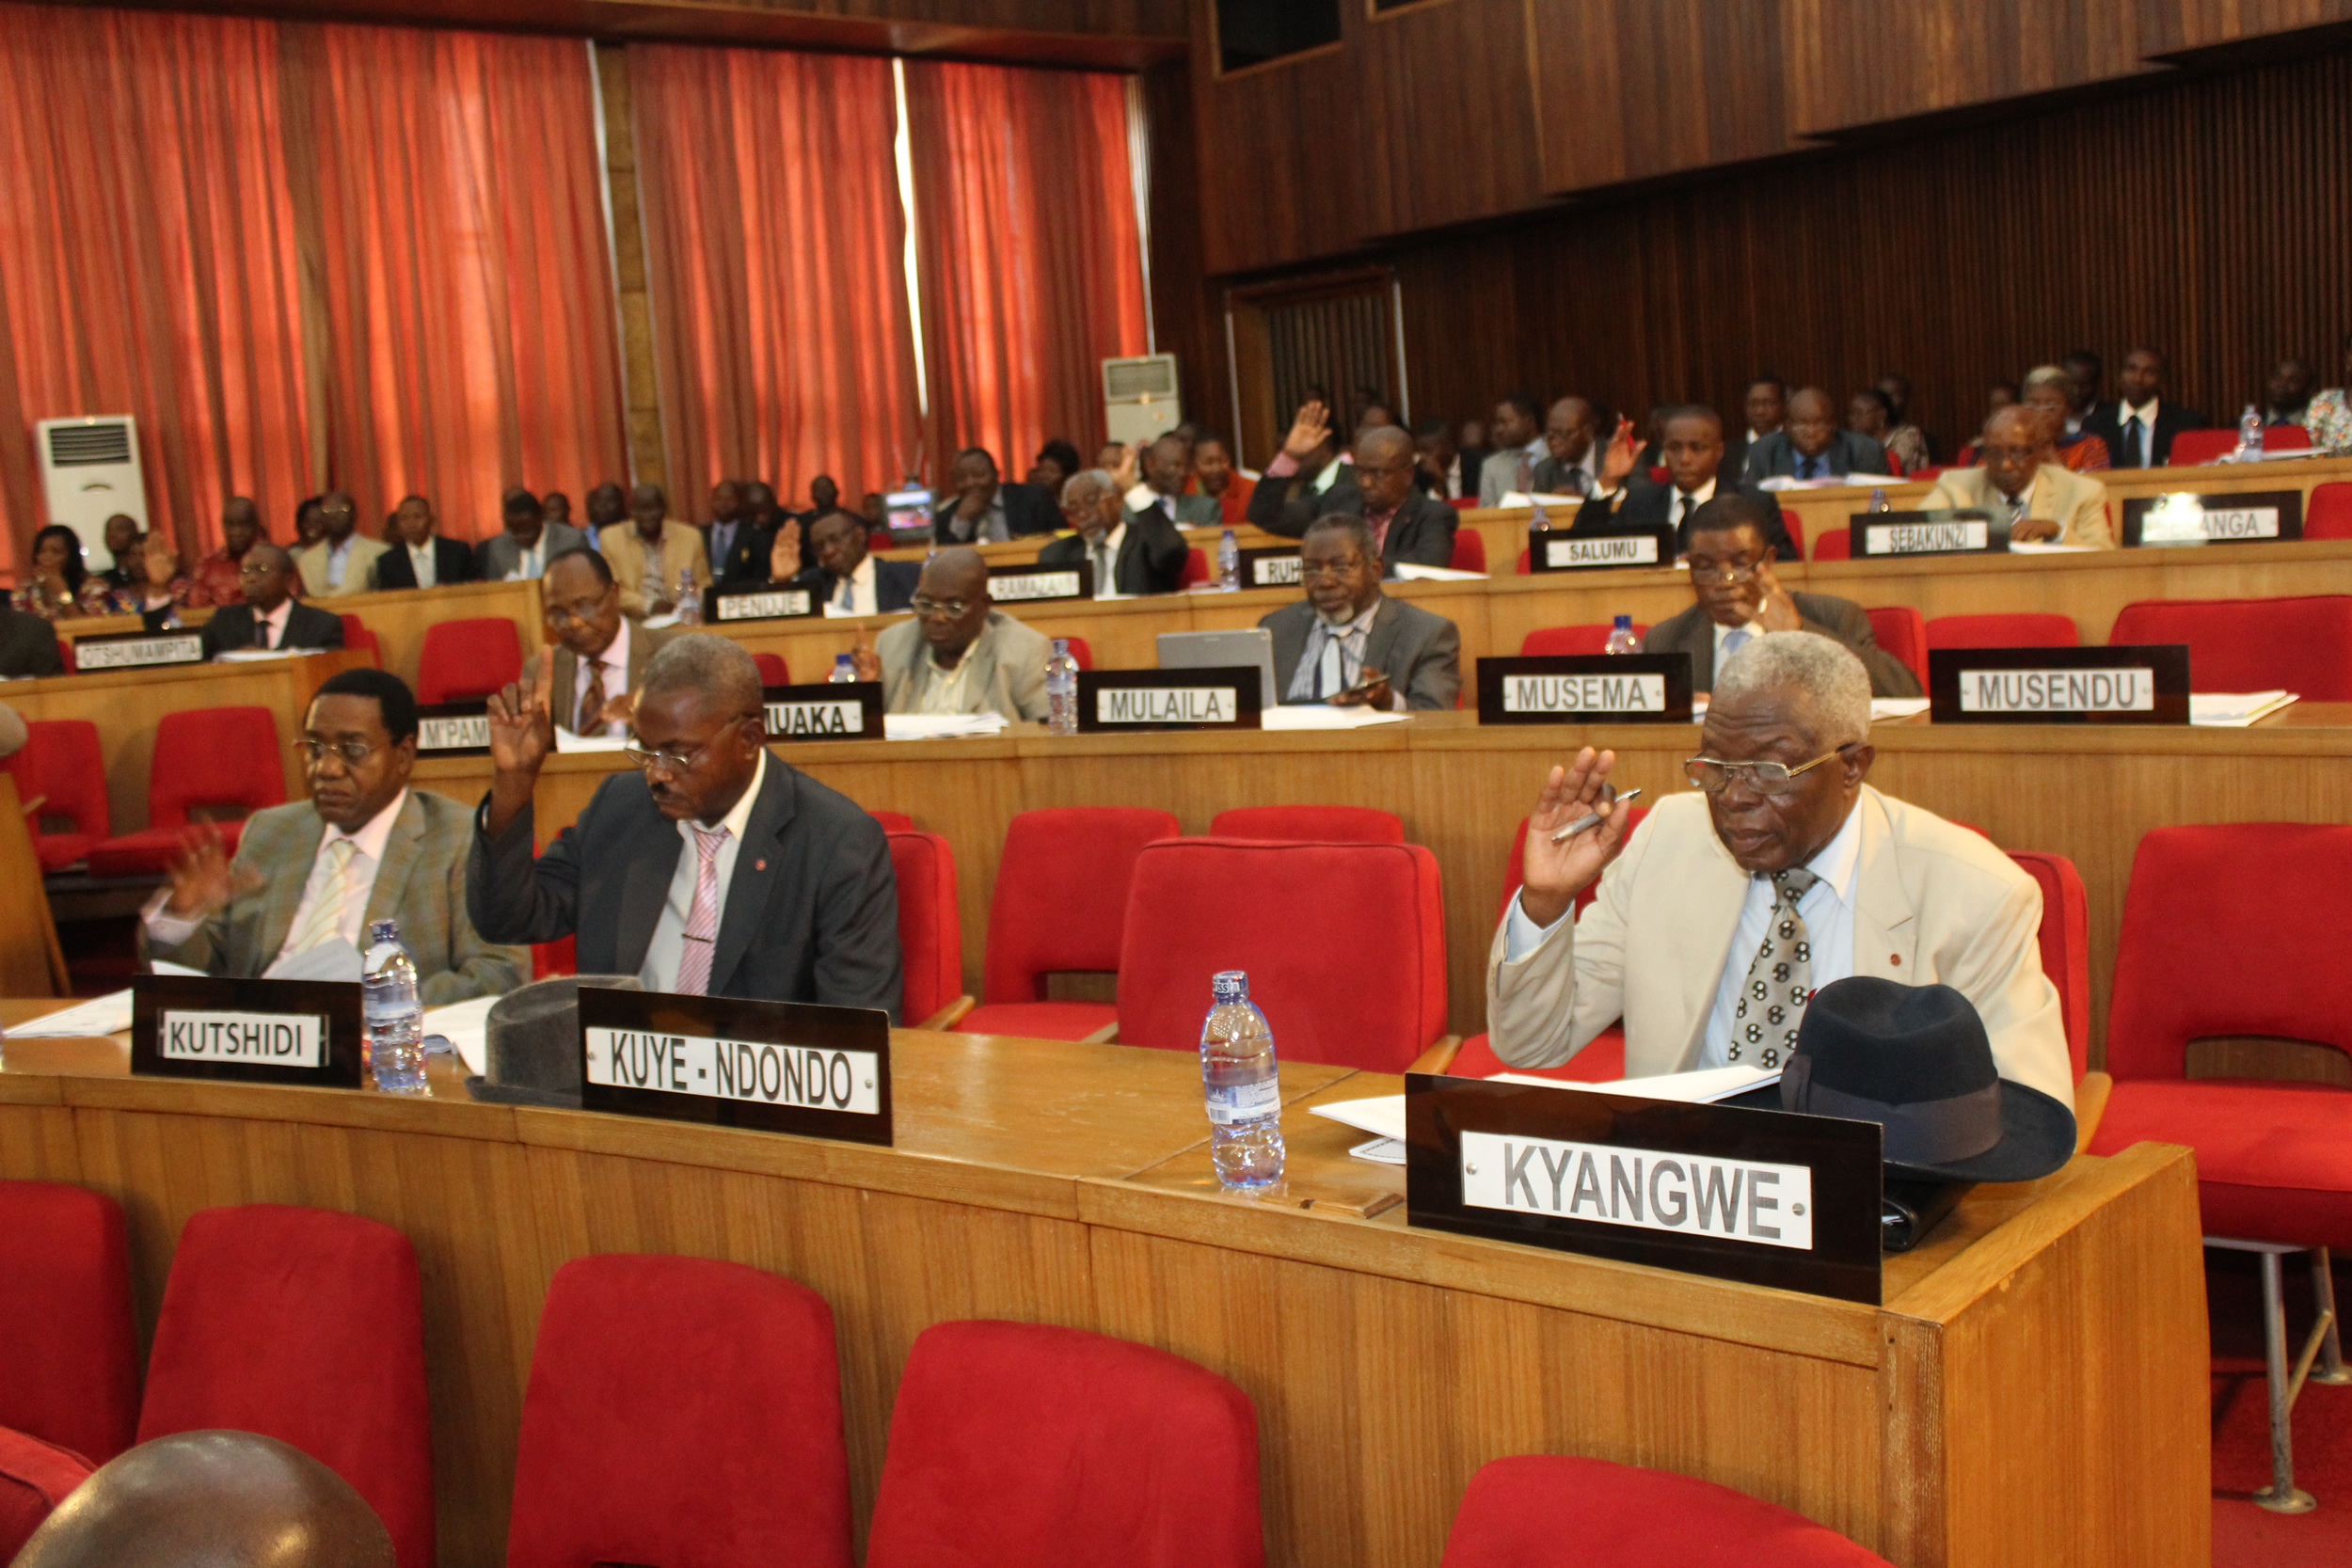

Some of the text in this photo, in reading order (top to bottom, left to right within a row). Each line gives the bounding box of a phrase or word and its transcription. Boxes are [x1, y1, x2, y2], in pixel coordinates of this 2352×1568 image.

[1569, 541, 1637, 562] SALUMU
[1889, 523, 1967, 553] SEBAKUNZI
[1267, 560, 1303, 583] RUH
[1110, 691, 1222, 721] MULAILA
[1517, 678, 1647, 710] MUSEMA
[1978, 673, 2136, 709] MUSENDU
[425, 720, 488, 748] M'PAM
[170, 1022, 302, 1056] KUTSHIDI
[611, 1032, 688, 1091] KUYE
[716, 1041, 852, 1110] NDONDO
[1504, 1142, 1782, 1240] KYANGWE
